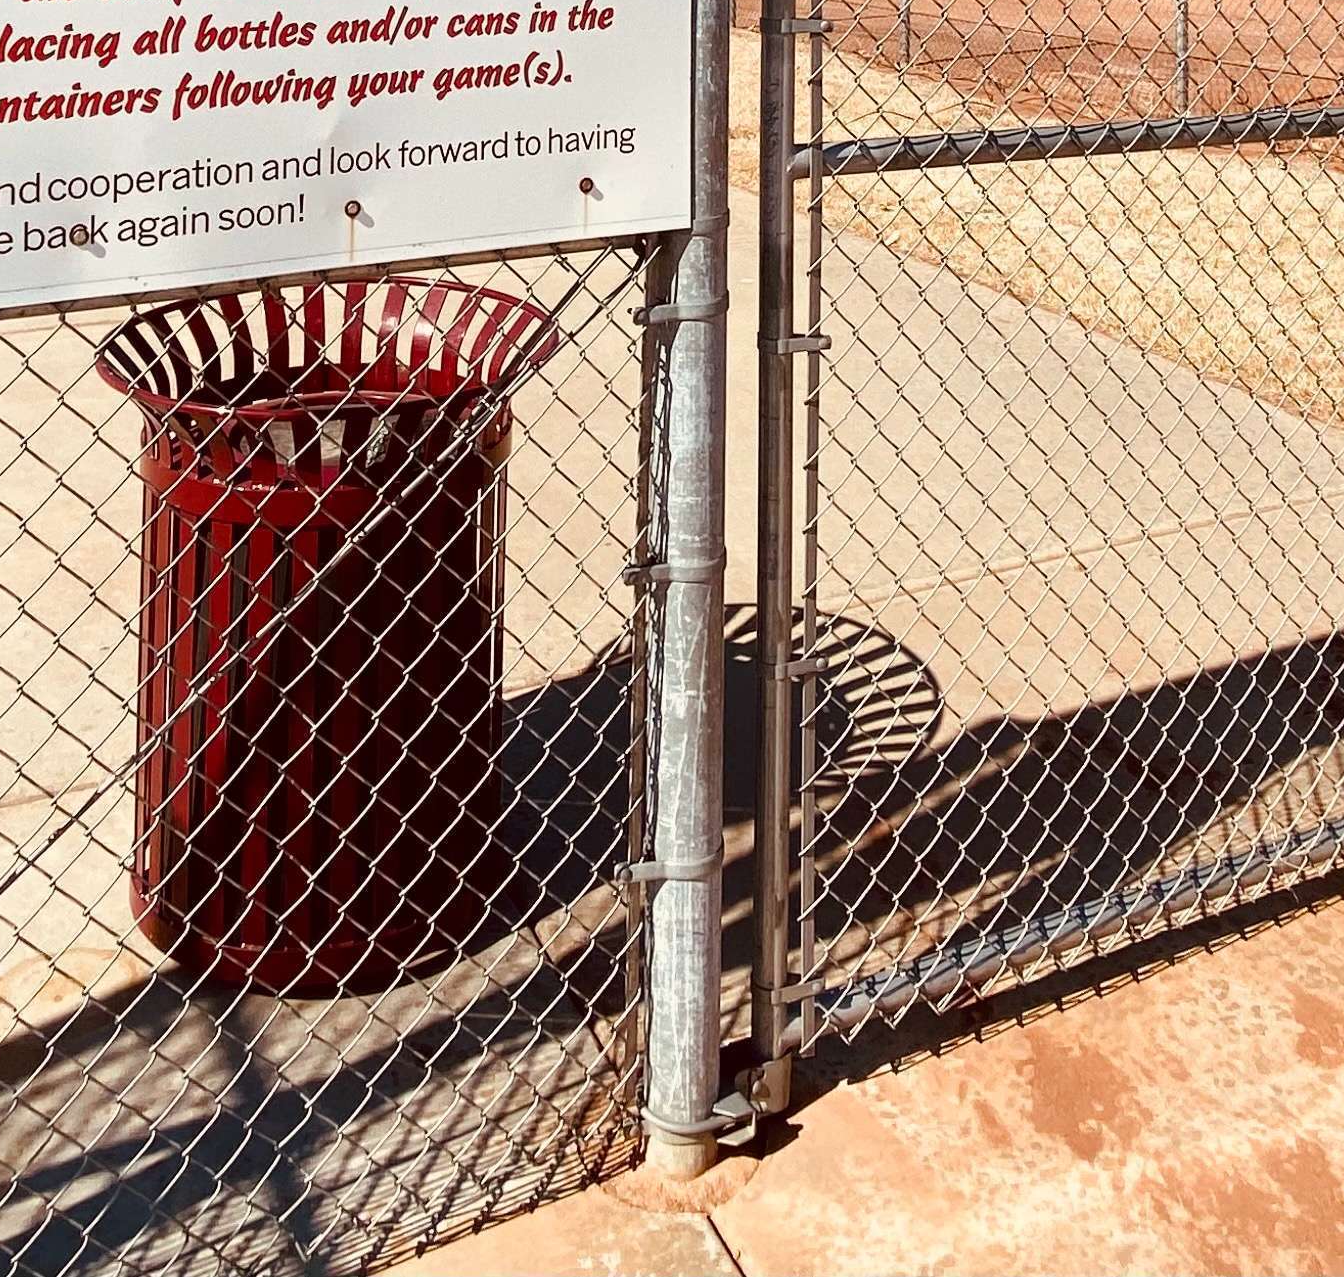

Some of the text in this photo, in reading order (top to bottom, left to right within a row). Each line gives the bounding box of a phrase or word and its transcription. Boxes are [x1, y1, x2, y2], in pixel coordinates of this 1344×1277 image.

[132, 15, 187, 56] all
[194, 10, 318, 53] bottles
[326, 5, 439, 46] and/or
[446, 11, 521, 38] cans
[528, 1, 558, 34] in
[172, 68, 337, 121] following
[347, 69, 425, 108] your
[432, 49, 572, 101] game(s).
[47, 159, 253, 204] cooperation
[261, 147, 321, 181] and
[330, 142, 392, 175] look
[397, 131, 508, 168] forward
[514, 130, 541, 157] to
[548, 123, 636, 154] having
[117, 211, 210, 247] again
[218, 193, 305, 231] soon!
